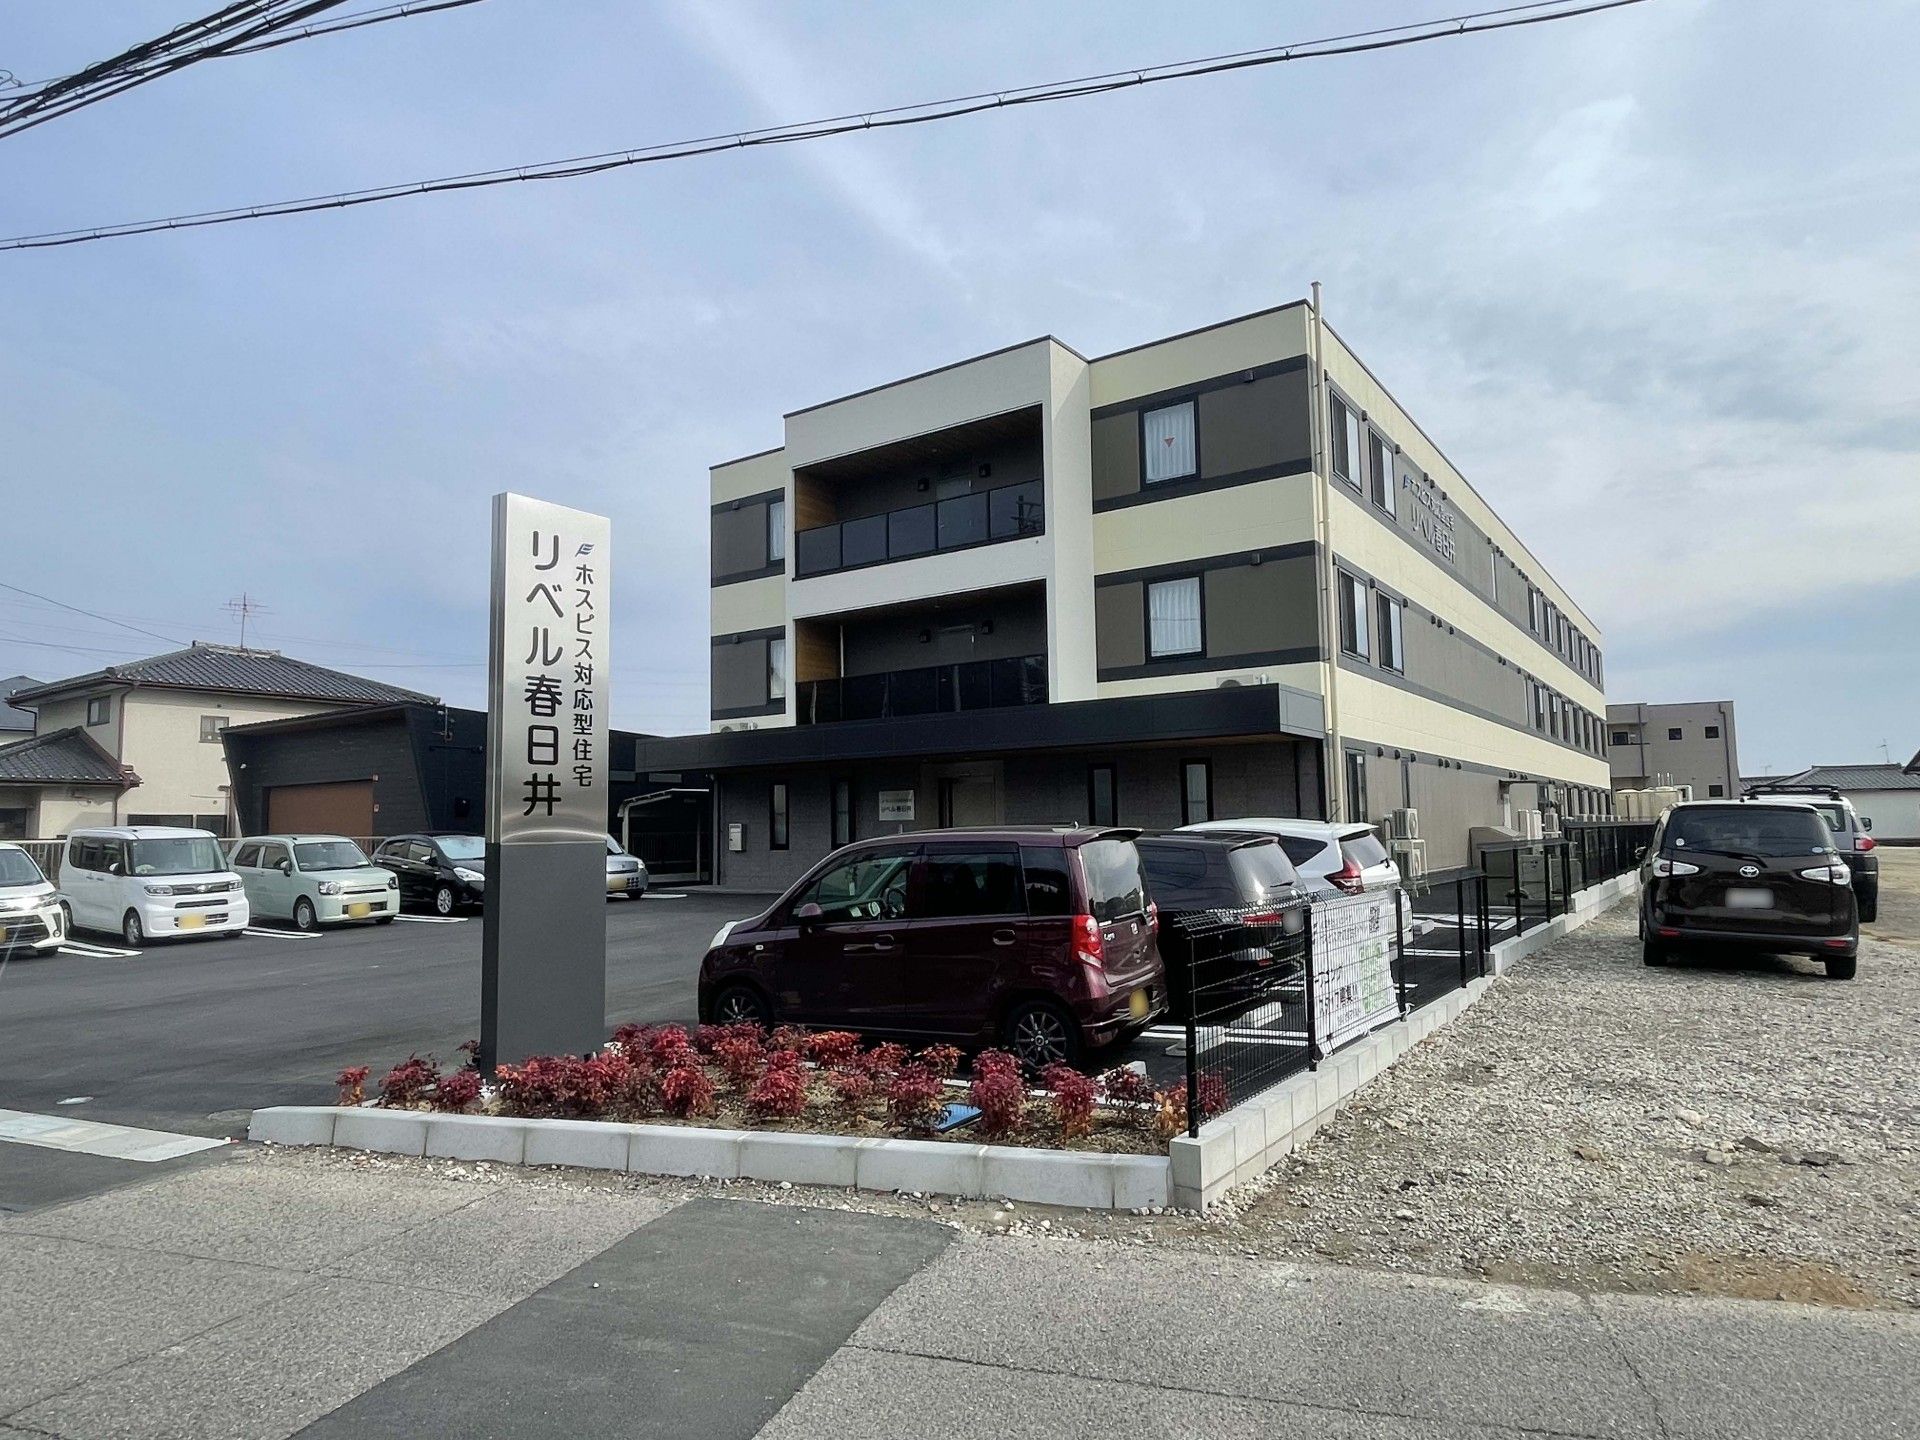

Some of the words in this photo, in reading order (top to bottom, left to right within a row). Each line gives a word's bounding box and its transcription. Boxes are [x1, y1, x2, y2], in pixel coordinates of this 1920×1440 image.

[523, 530, 564, 817] リベル春日井
[572, 564, 595, 788] ホスピス対応型住宅
